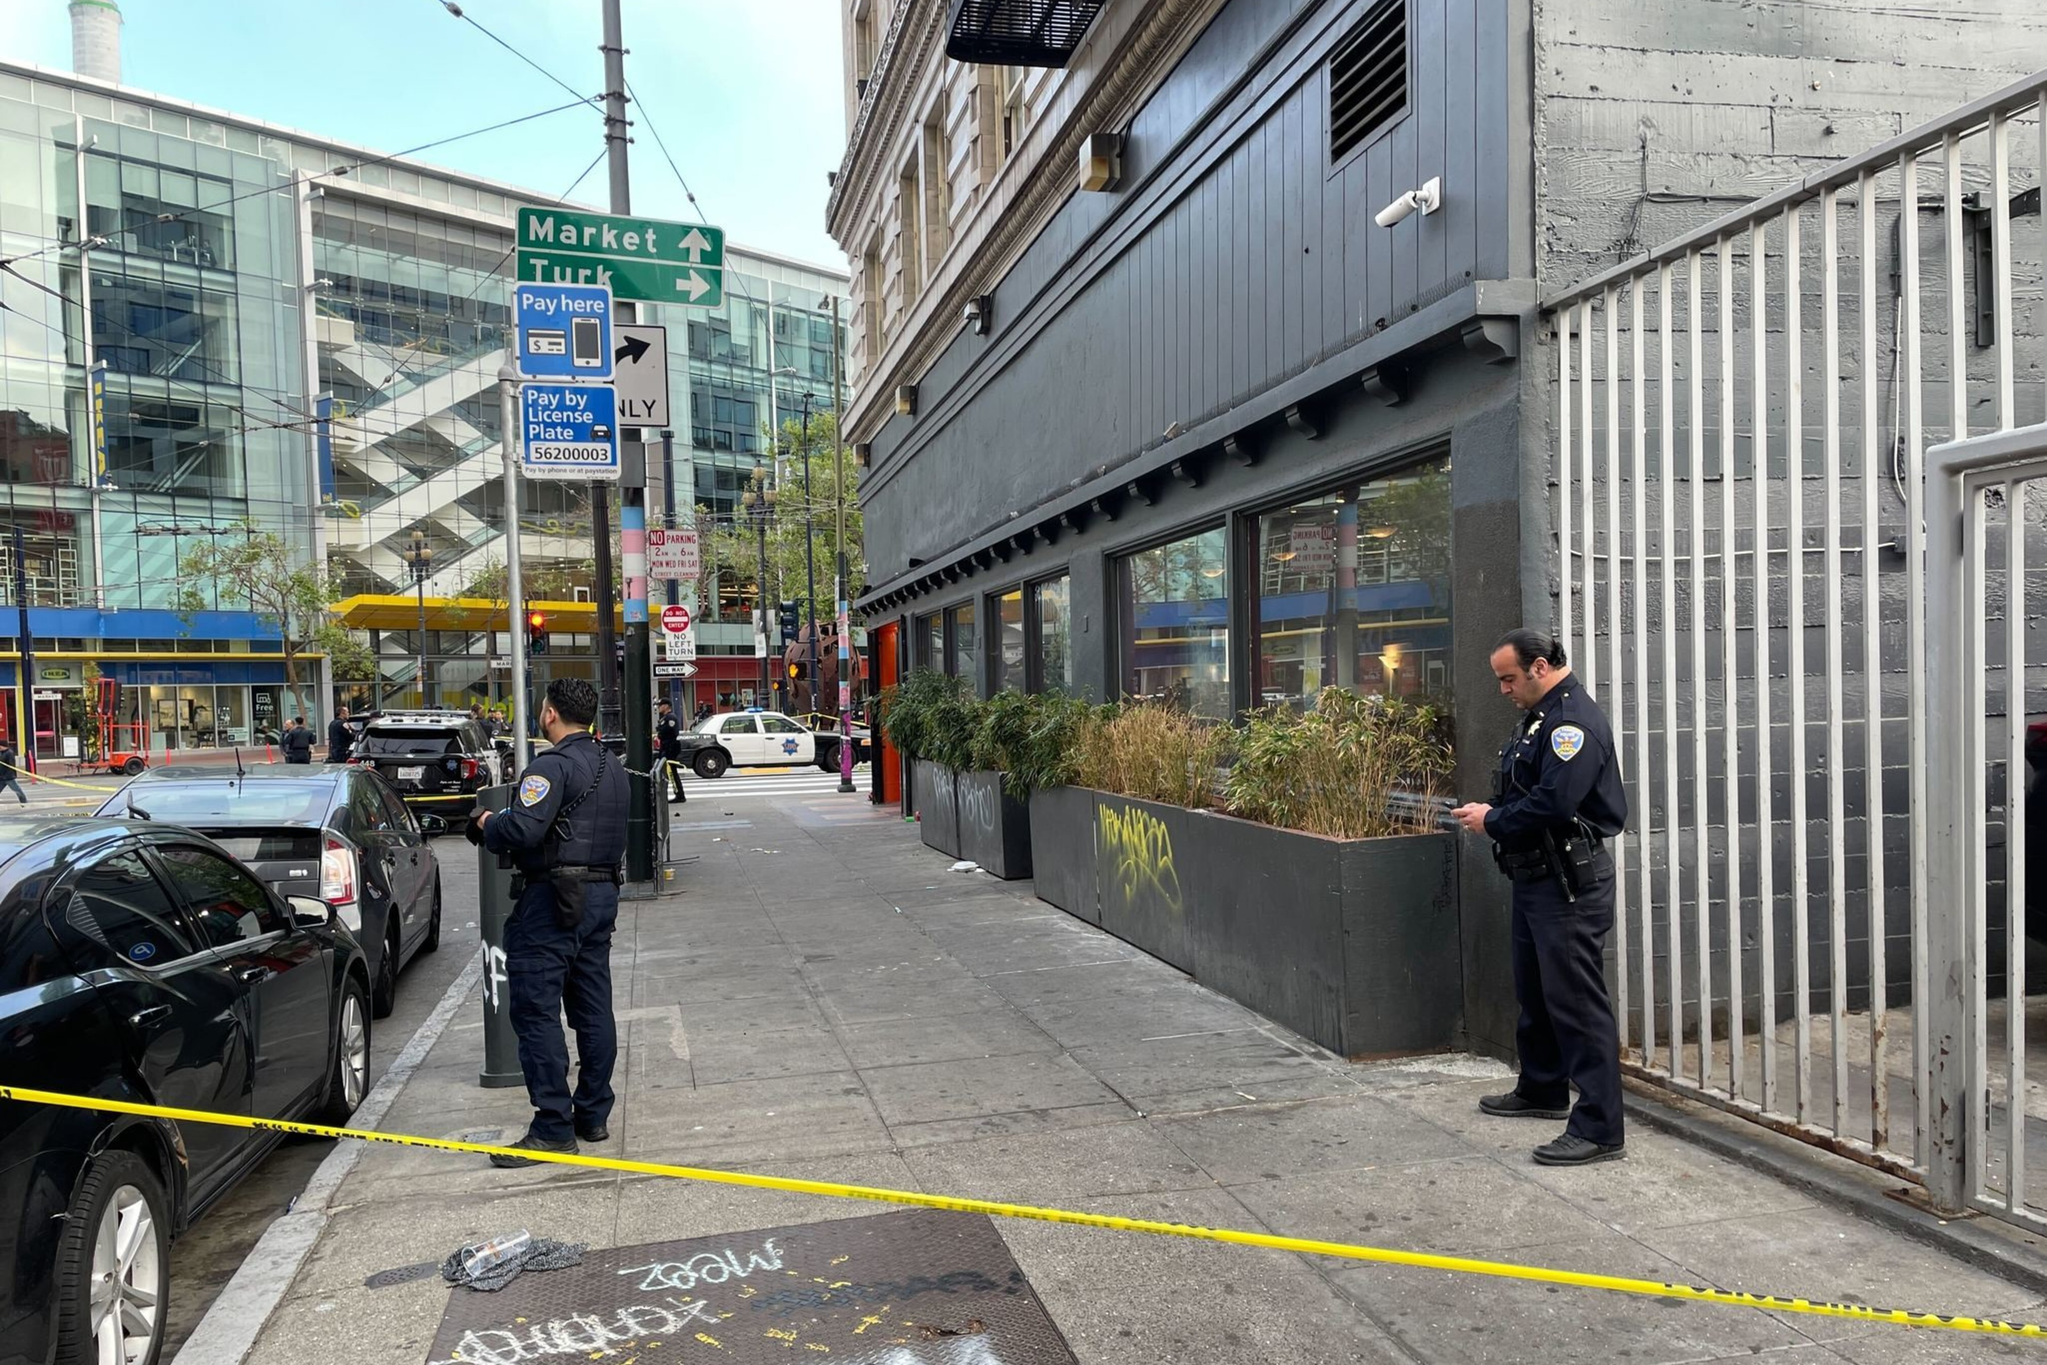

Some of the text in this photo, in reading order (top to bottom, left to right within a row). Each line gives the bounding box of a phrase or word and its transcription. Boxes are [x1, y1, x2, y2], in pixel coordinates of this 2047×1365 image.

[529, 215, 657, 253] Market
[529, 258, 613, 288] Turk
[522, 293, 605, 316] Pay here
[528, 389, 588, 410] Pay by
[618, 399, 656, 418] NLY
[528, 406, 594, 424] License
[529, 423, 574, 440] Plate
[534, 447, 608, 461] 56200003
[585, 467, 618, 475] paystation
[650, 531, 697, 545] NO PARKING
[651, 560, 698, 568] MON WED FRI SAT
